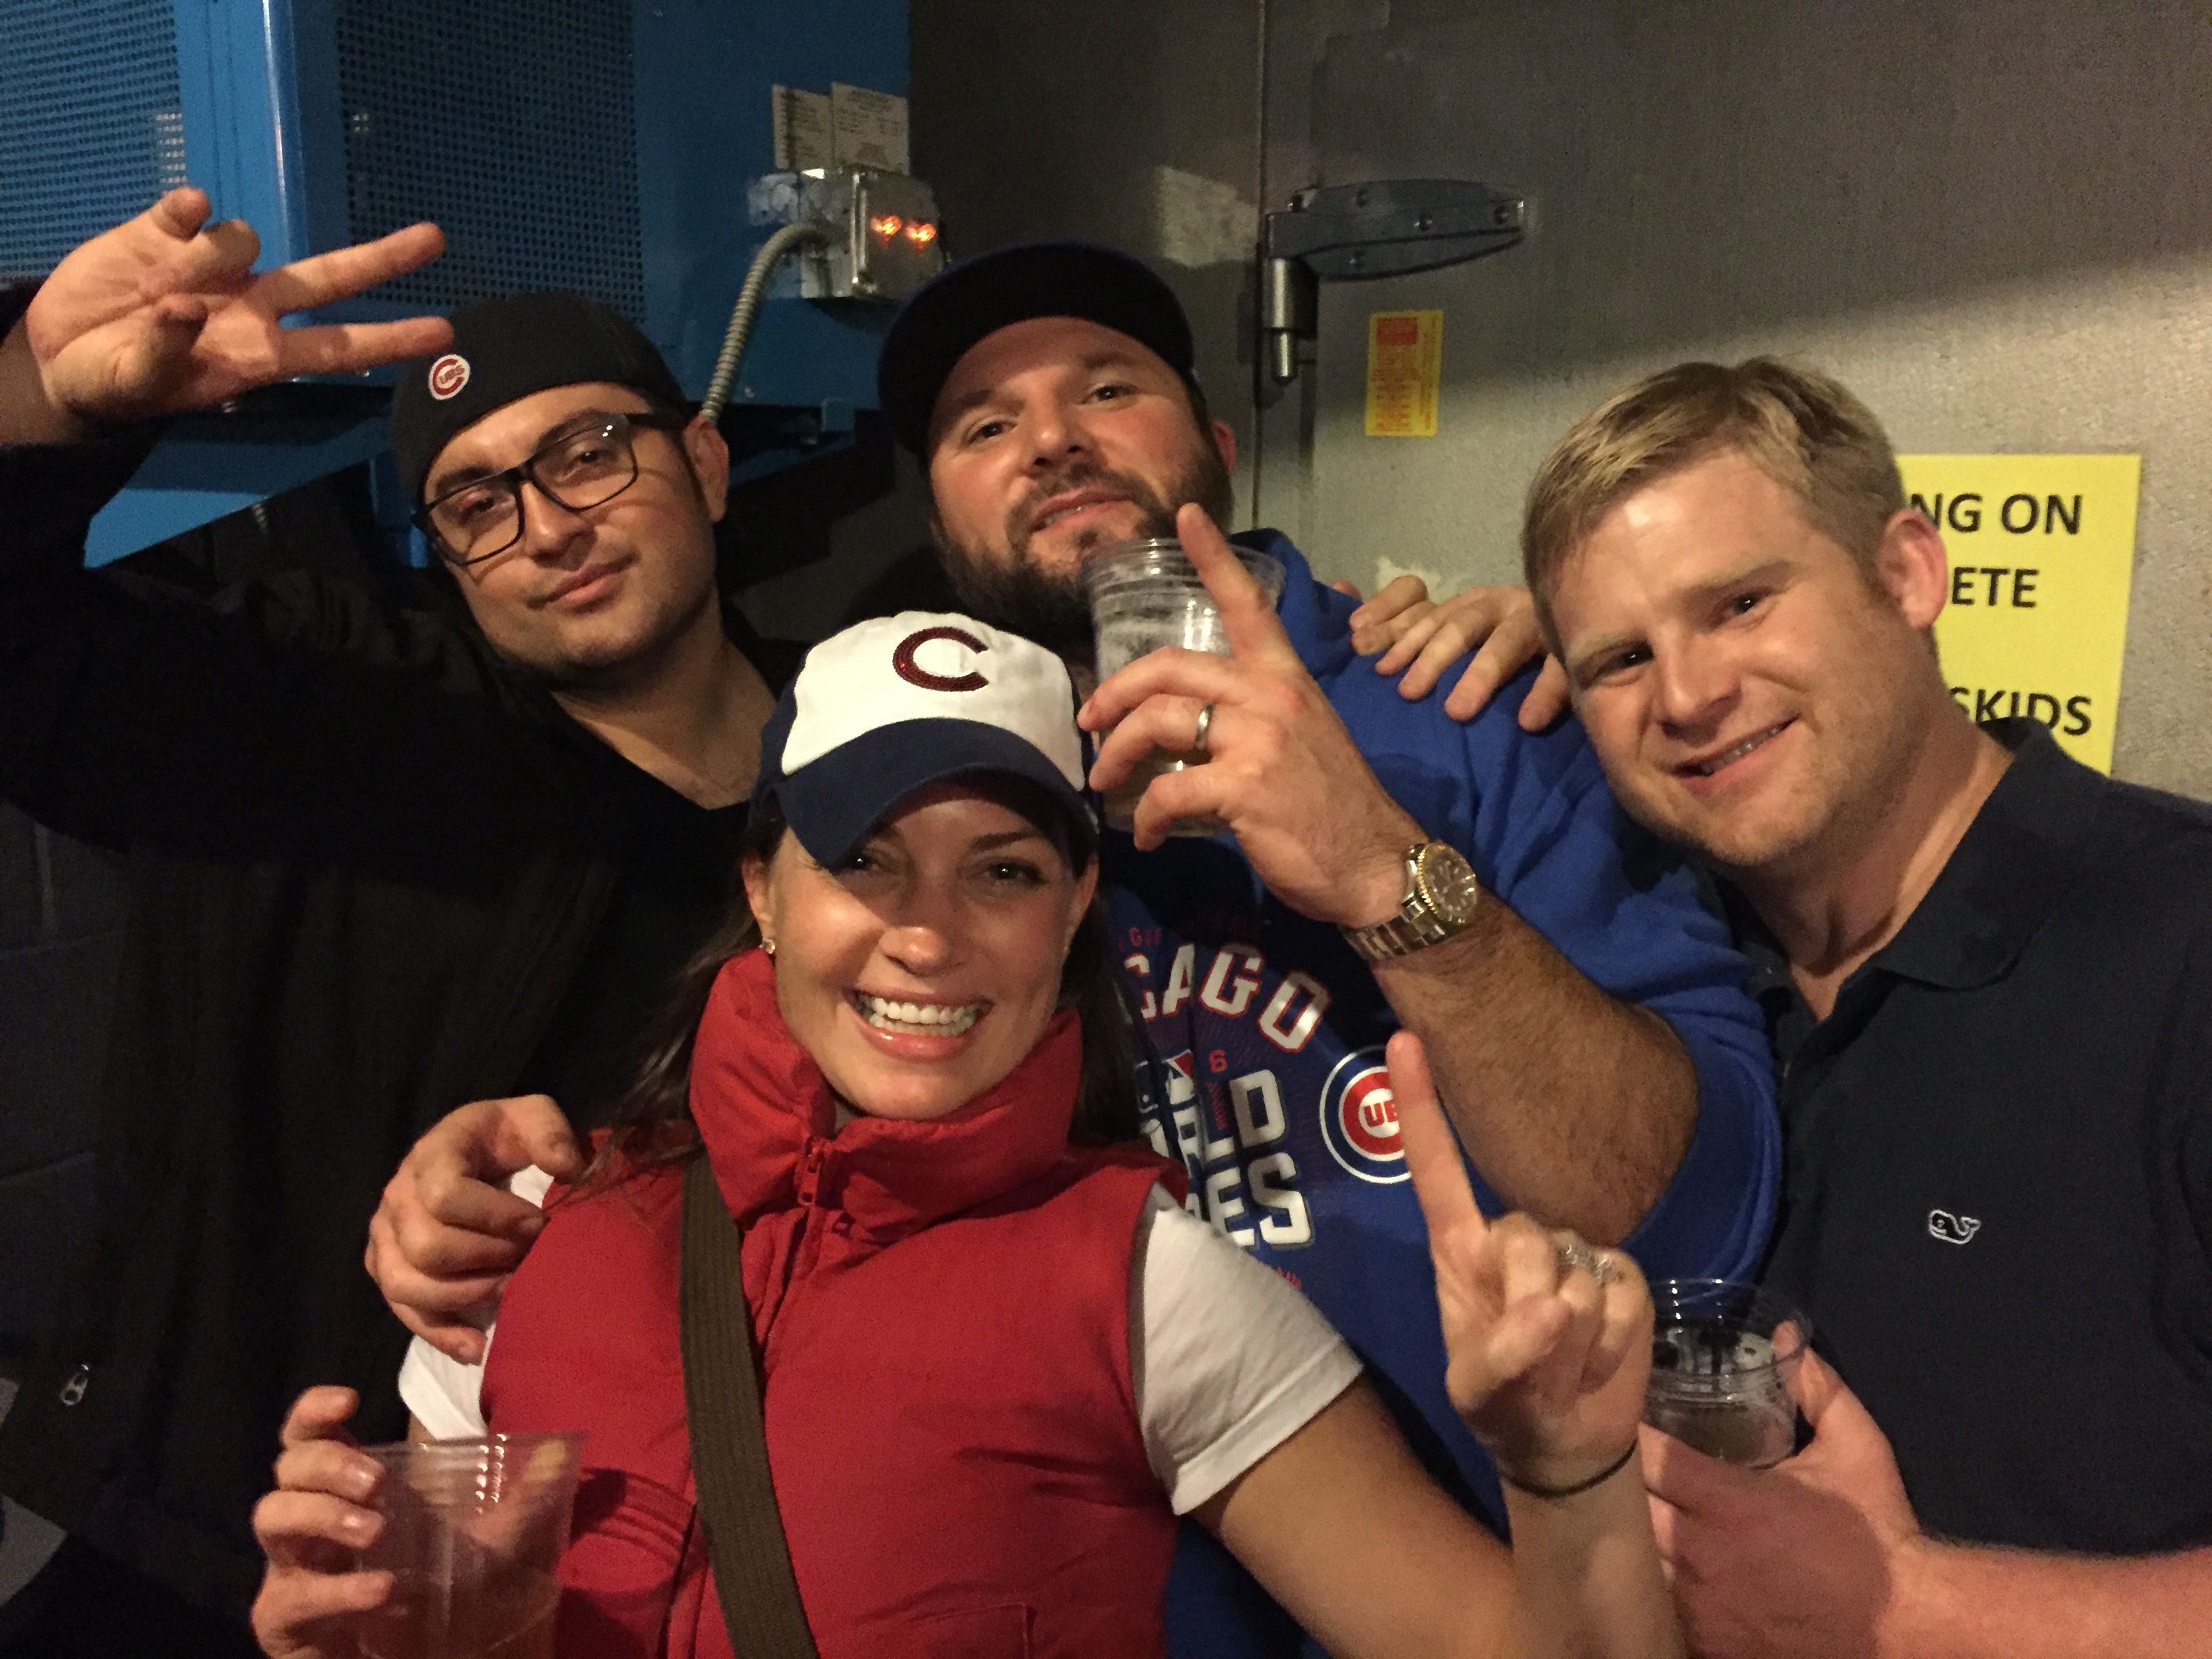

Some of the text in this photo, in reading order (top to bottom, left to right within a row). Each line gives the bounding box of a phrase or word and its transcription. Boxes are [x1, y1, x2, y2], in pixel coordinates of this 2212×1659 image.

[2001, 493, 2083, 535] ON
[1952, 567, 2040, 608] ETE
[892, 626, 989, 692] C
[1949, 686, 2093, 737] SKIDS
